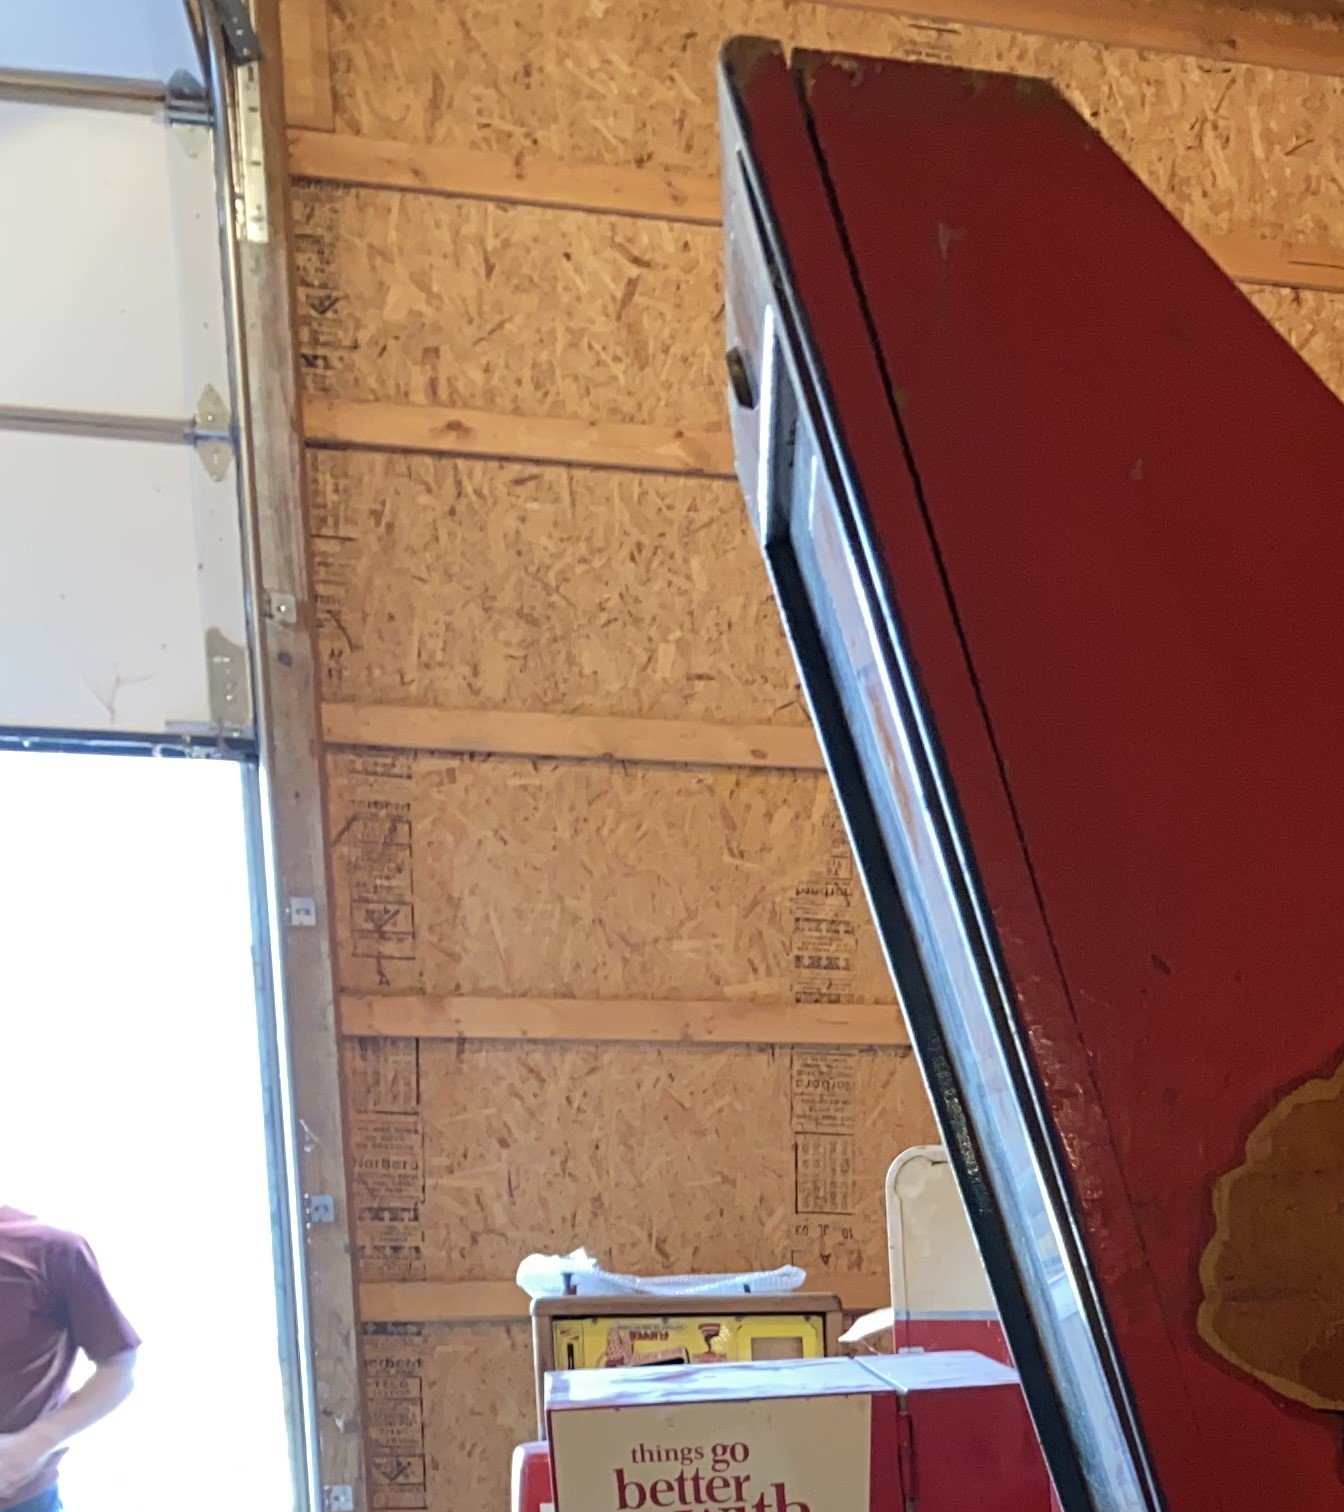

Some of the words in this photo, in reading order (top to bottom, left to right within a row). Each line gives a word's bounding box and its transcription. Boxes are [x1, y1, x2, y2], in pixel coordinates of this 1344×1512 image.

[631, 1443, 704, 1466] things
[711, 1441, 749, 1471] go
[614, 1467, 751, 1511] better
